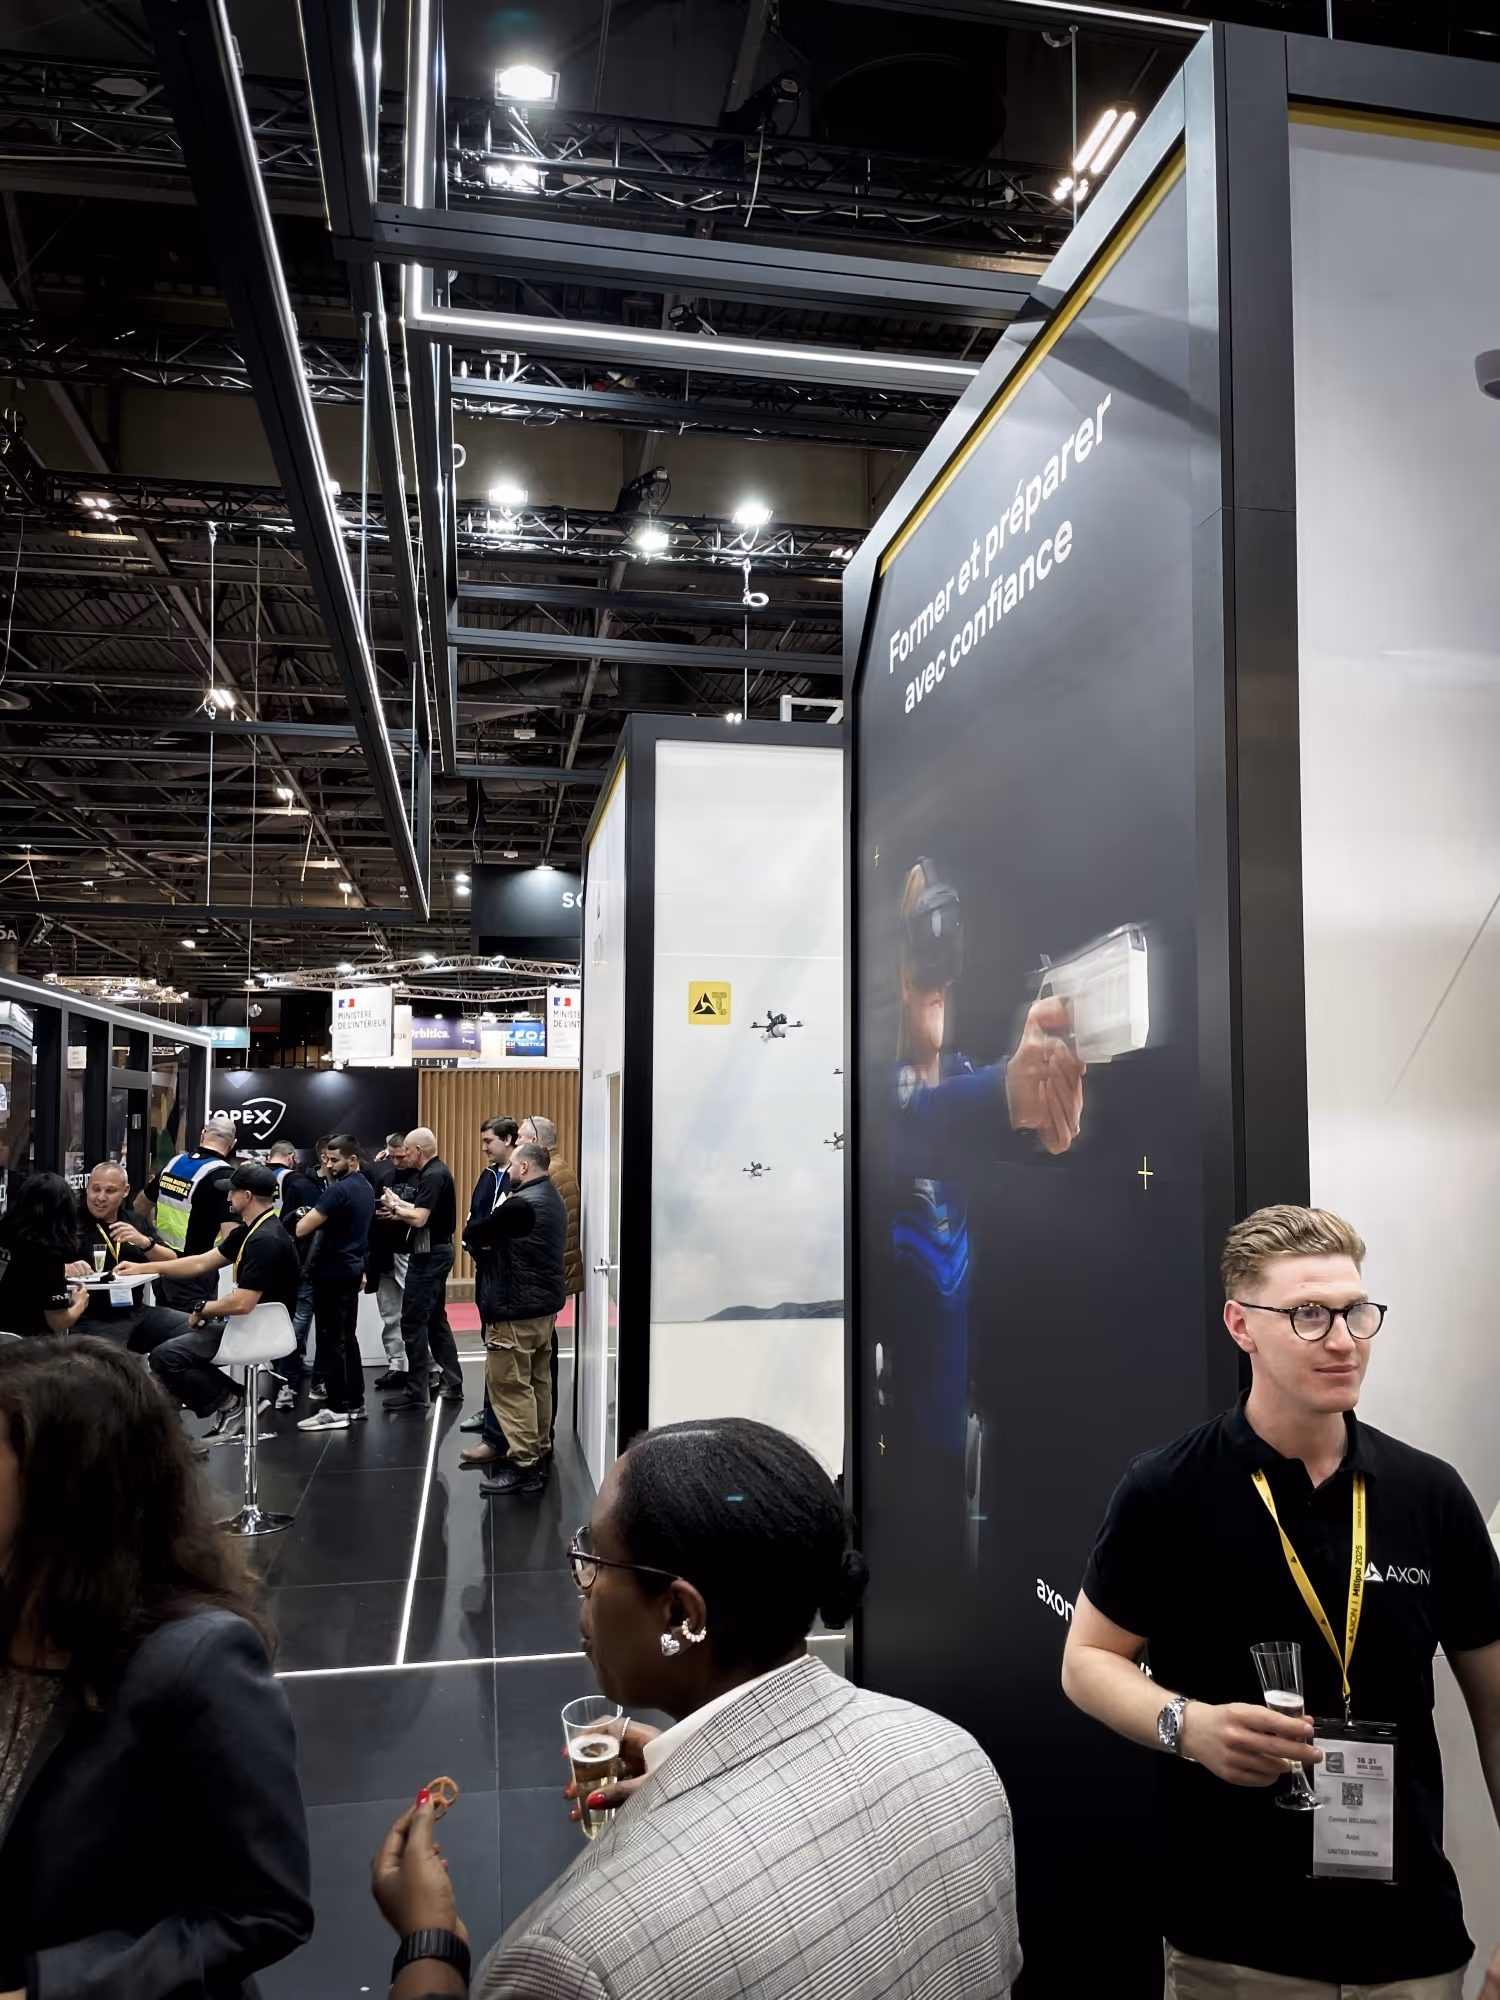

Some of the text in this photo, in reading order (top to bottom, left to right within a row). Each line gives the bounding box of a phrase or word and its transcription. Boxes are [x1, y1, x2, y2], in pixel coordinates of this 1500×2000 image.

[889, 393, 1112, 674] Former et préparer
[905, 520, 1073, 714] avec confiance
[337, 1021, 346, 1030] DE
[553, 1020, 562, 1028] DE
[209, 1109, 273, 1125] OPEX
[1355, 1545, 1363, 1566] 2025
[1386, 1564, 1431, 1586] AXON
